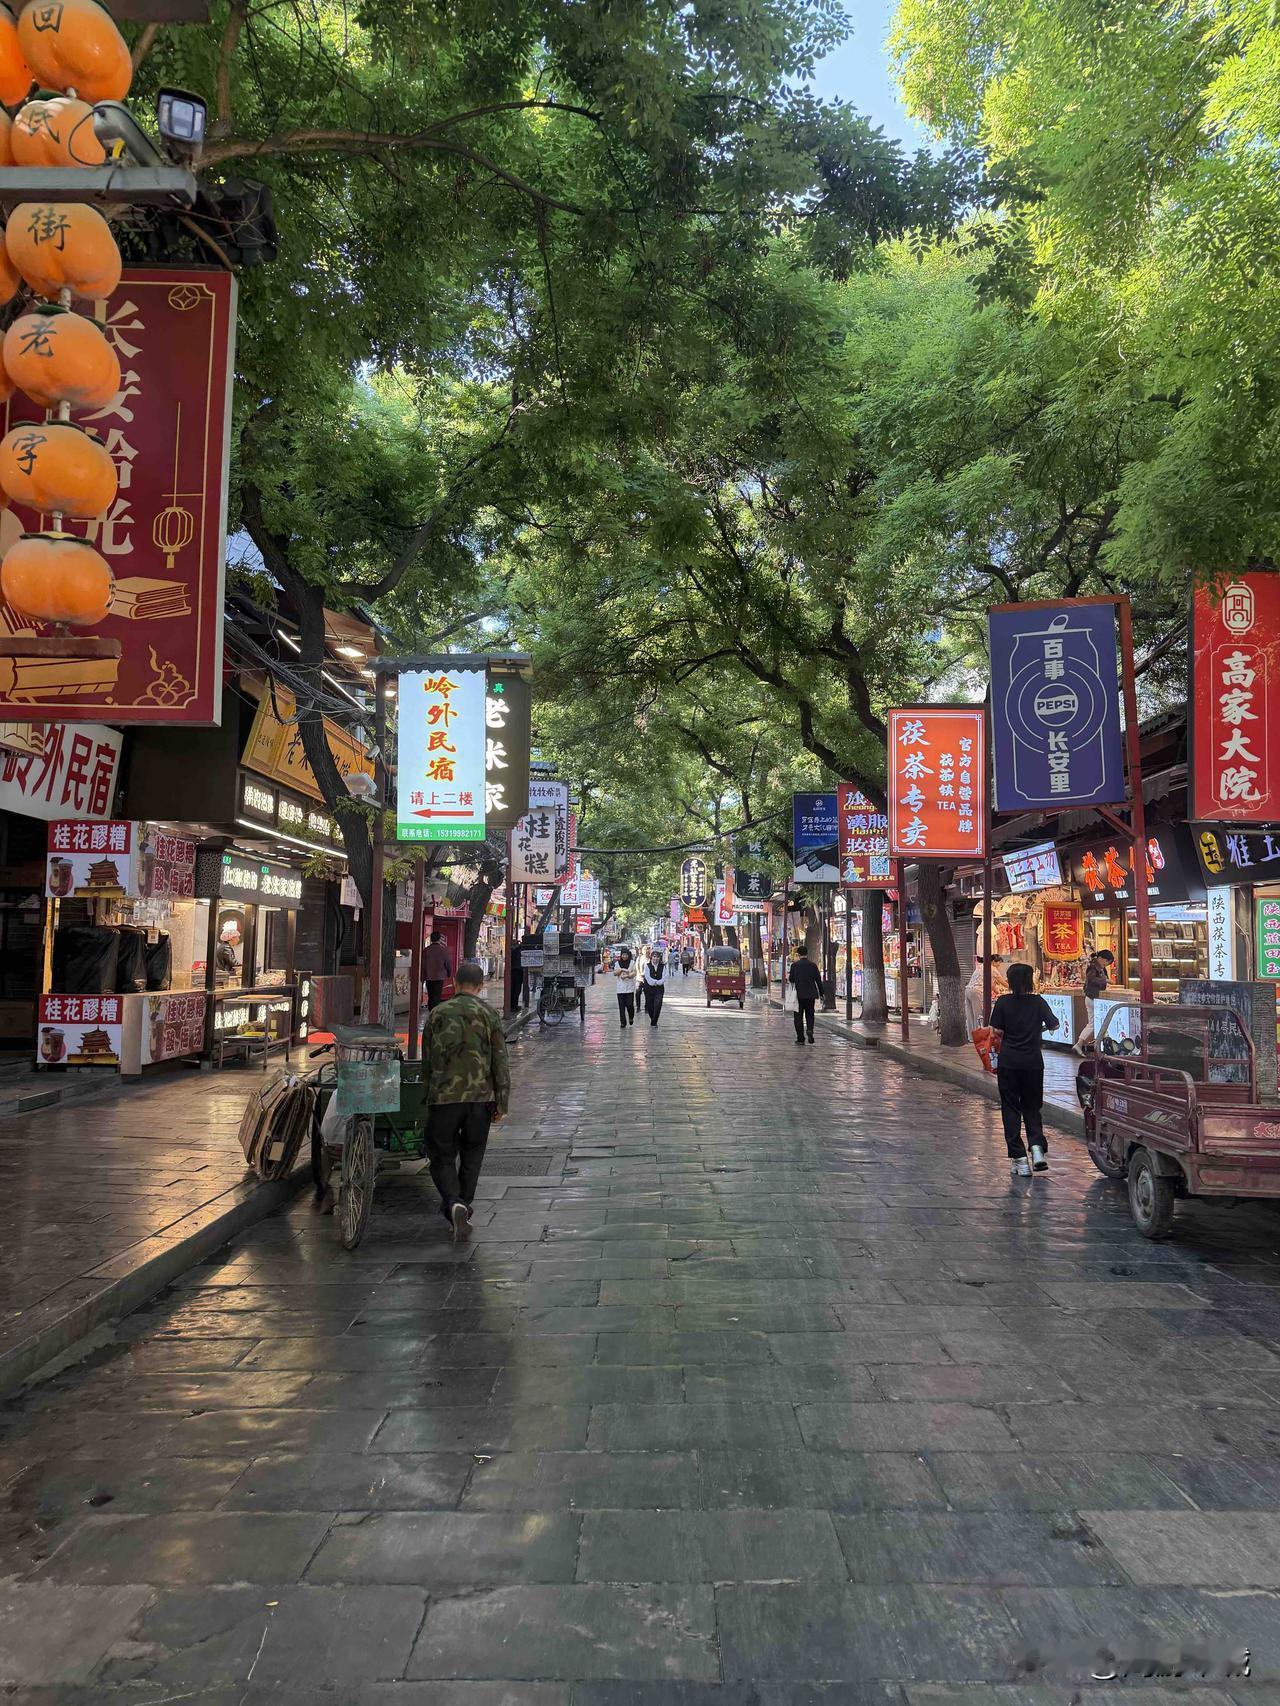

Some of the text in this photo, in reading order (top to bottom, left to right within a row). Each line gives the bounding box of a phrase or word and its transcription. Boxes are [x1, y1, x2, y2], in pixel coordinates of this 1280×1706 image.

[32, 4, 62, 33] 回
[27, 208, 71, 251] 街
[19, 322, 57, 357] 老
[12, 433, 47, 476] 字
[1043, 639, 1065, 680] 百事
[1037, 699, 1076, 711] PEPSI
[1218, 651, 1261, 801] 高家大院
[423, 676, 461, 782] 岭外民宿
[899, 720, 935, 846] 茯茶专卖
[1048, 731, 1071, 793] 长安里
[410, 791, 473, 806] 请上二楼
[937, 801, 956, 810] TEA
[958, 737, 973, 833] 官方自营品牌
[53, 824, 127, 850] 桂花醪糟
[518, 812, 550, 875] 桂花糕
[1050, 922, 1076, 940] 茶
[1212, 894, 1228, 978] 陕西茯茶专
[44, 997, 118, 1022] 桂花醪糟
